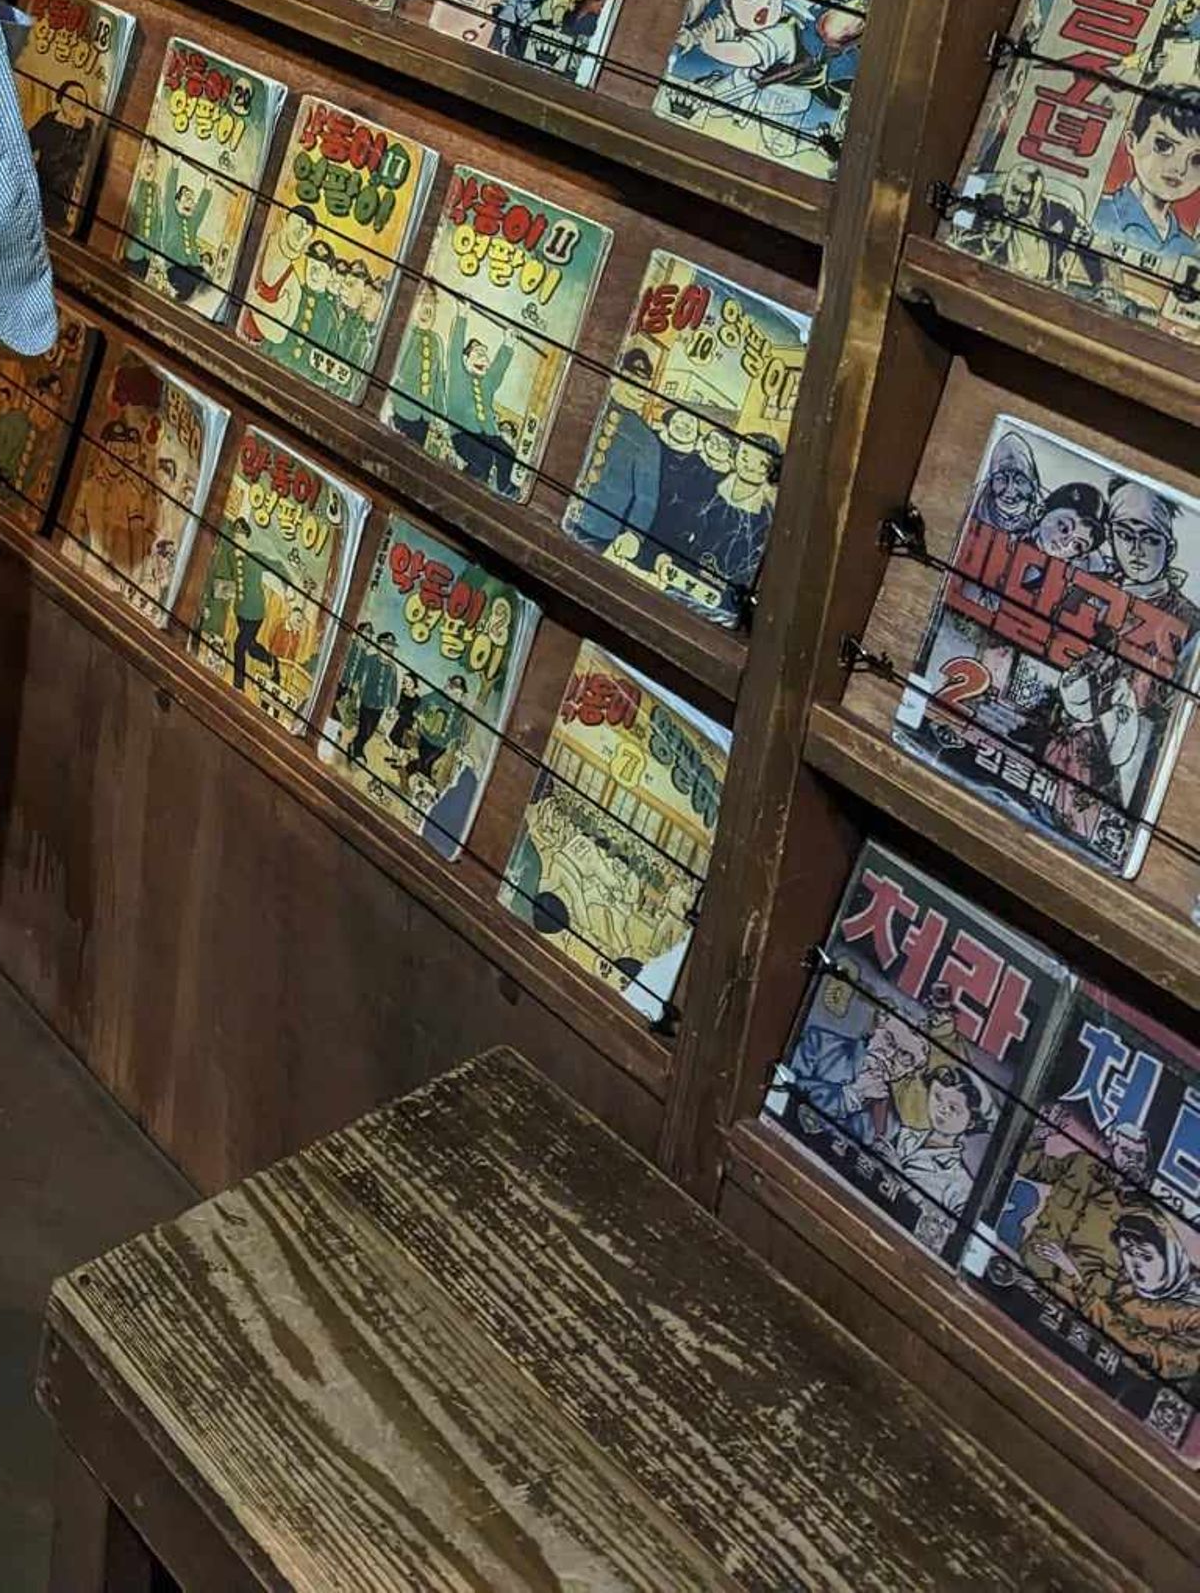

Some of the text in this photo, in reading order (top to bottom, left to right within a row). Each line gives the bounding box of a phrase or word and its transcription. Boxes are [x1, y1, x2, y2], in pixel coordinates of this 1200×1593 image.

[169, 90, 245, 153] 영팔이
[294, 152, 395, 235] 영팔이
[382, 155, 408, 184] 17
[452, 225, 562, 306] 영팔이
[546, 226, 576, 258] 11
[248, 491, 326, 558] 영팔이
[405, 592, 503, 679] 영팔이
[937, 656, 992, 718] 2
[975, 746, 1059, 808] 김종래
